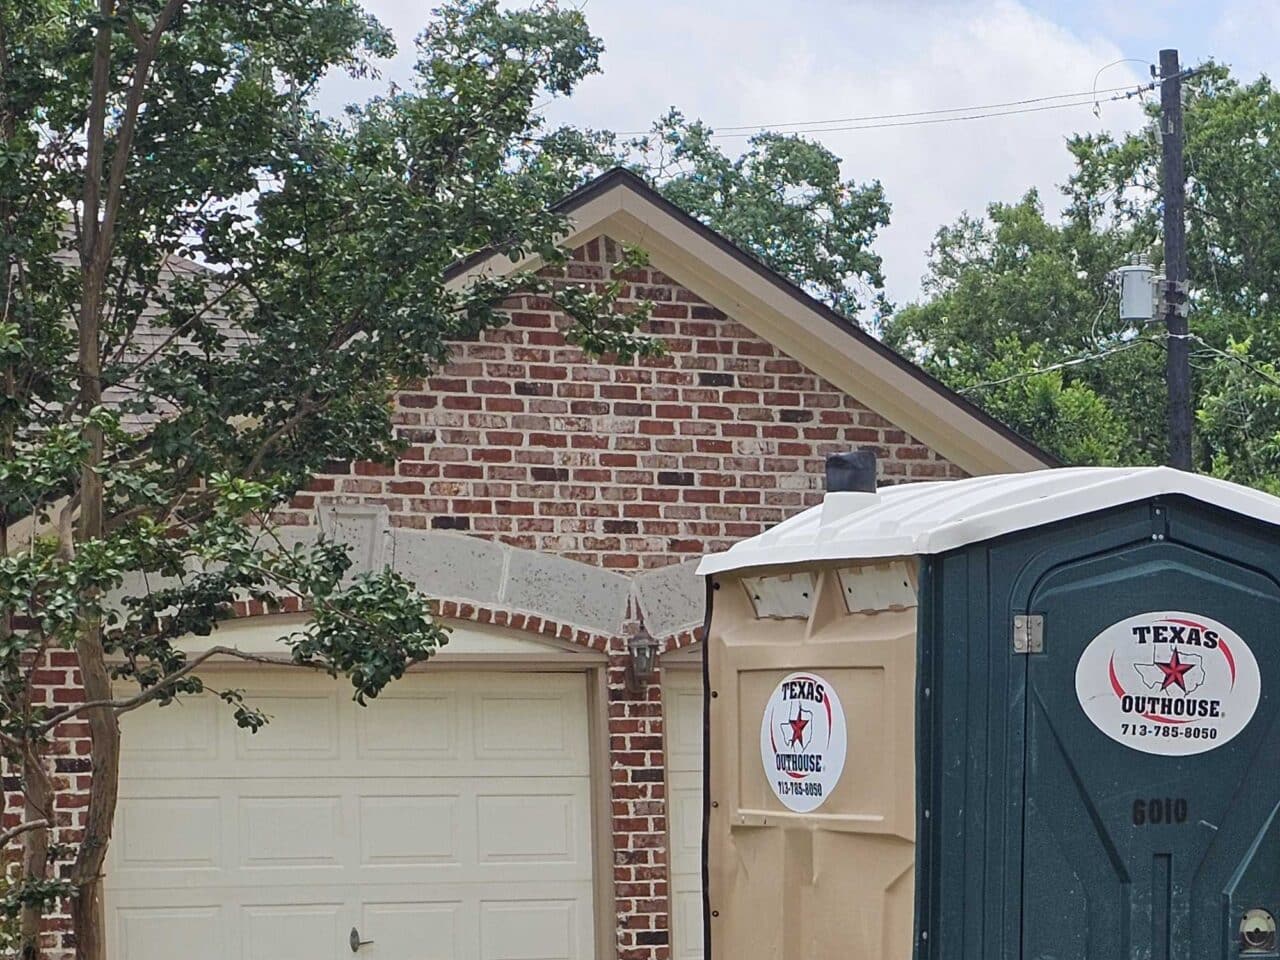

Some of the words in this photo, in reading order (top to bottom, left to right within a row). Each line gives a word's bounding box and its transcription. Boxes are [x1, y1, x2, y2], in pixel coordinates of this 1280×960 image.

[1133, 626, 1219, 649] TEXAS
[782, 680, 824, 703] TEXAS
[1122, 695, 1220, 717] OUTHOUSE
[1121, 724, 1217, 739] 713-785-8050
[776, 753, 822, 772] OUTHOUSE
[778, 781, 823, 796] 713-785-8050
[1132, 798, 1188, 826] 6010
